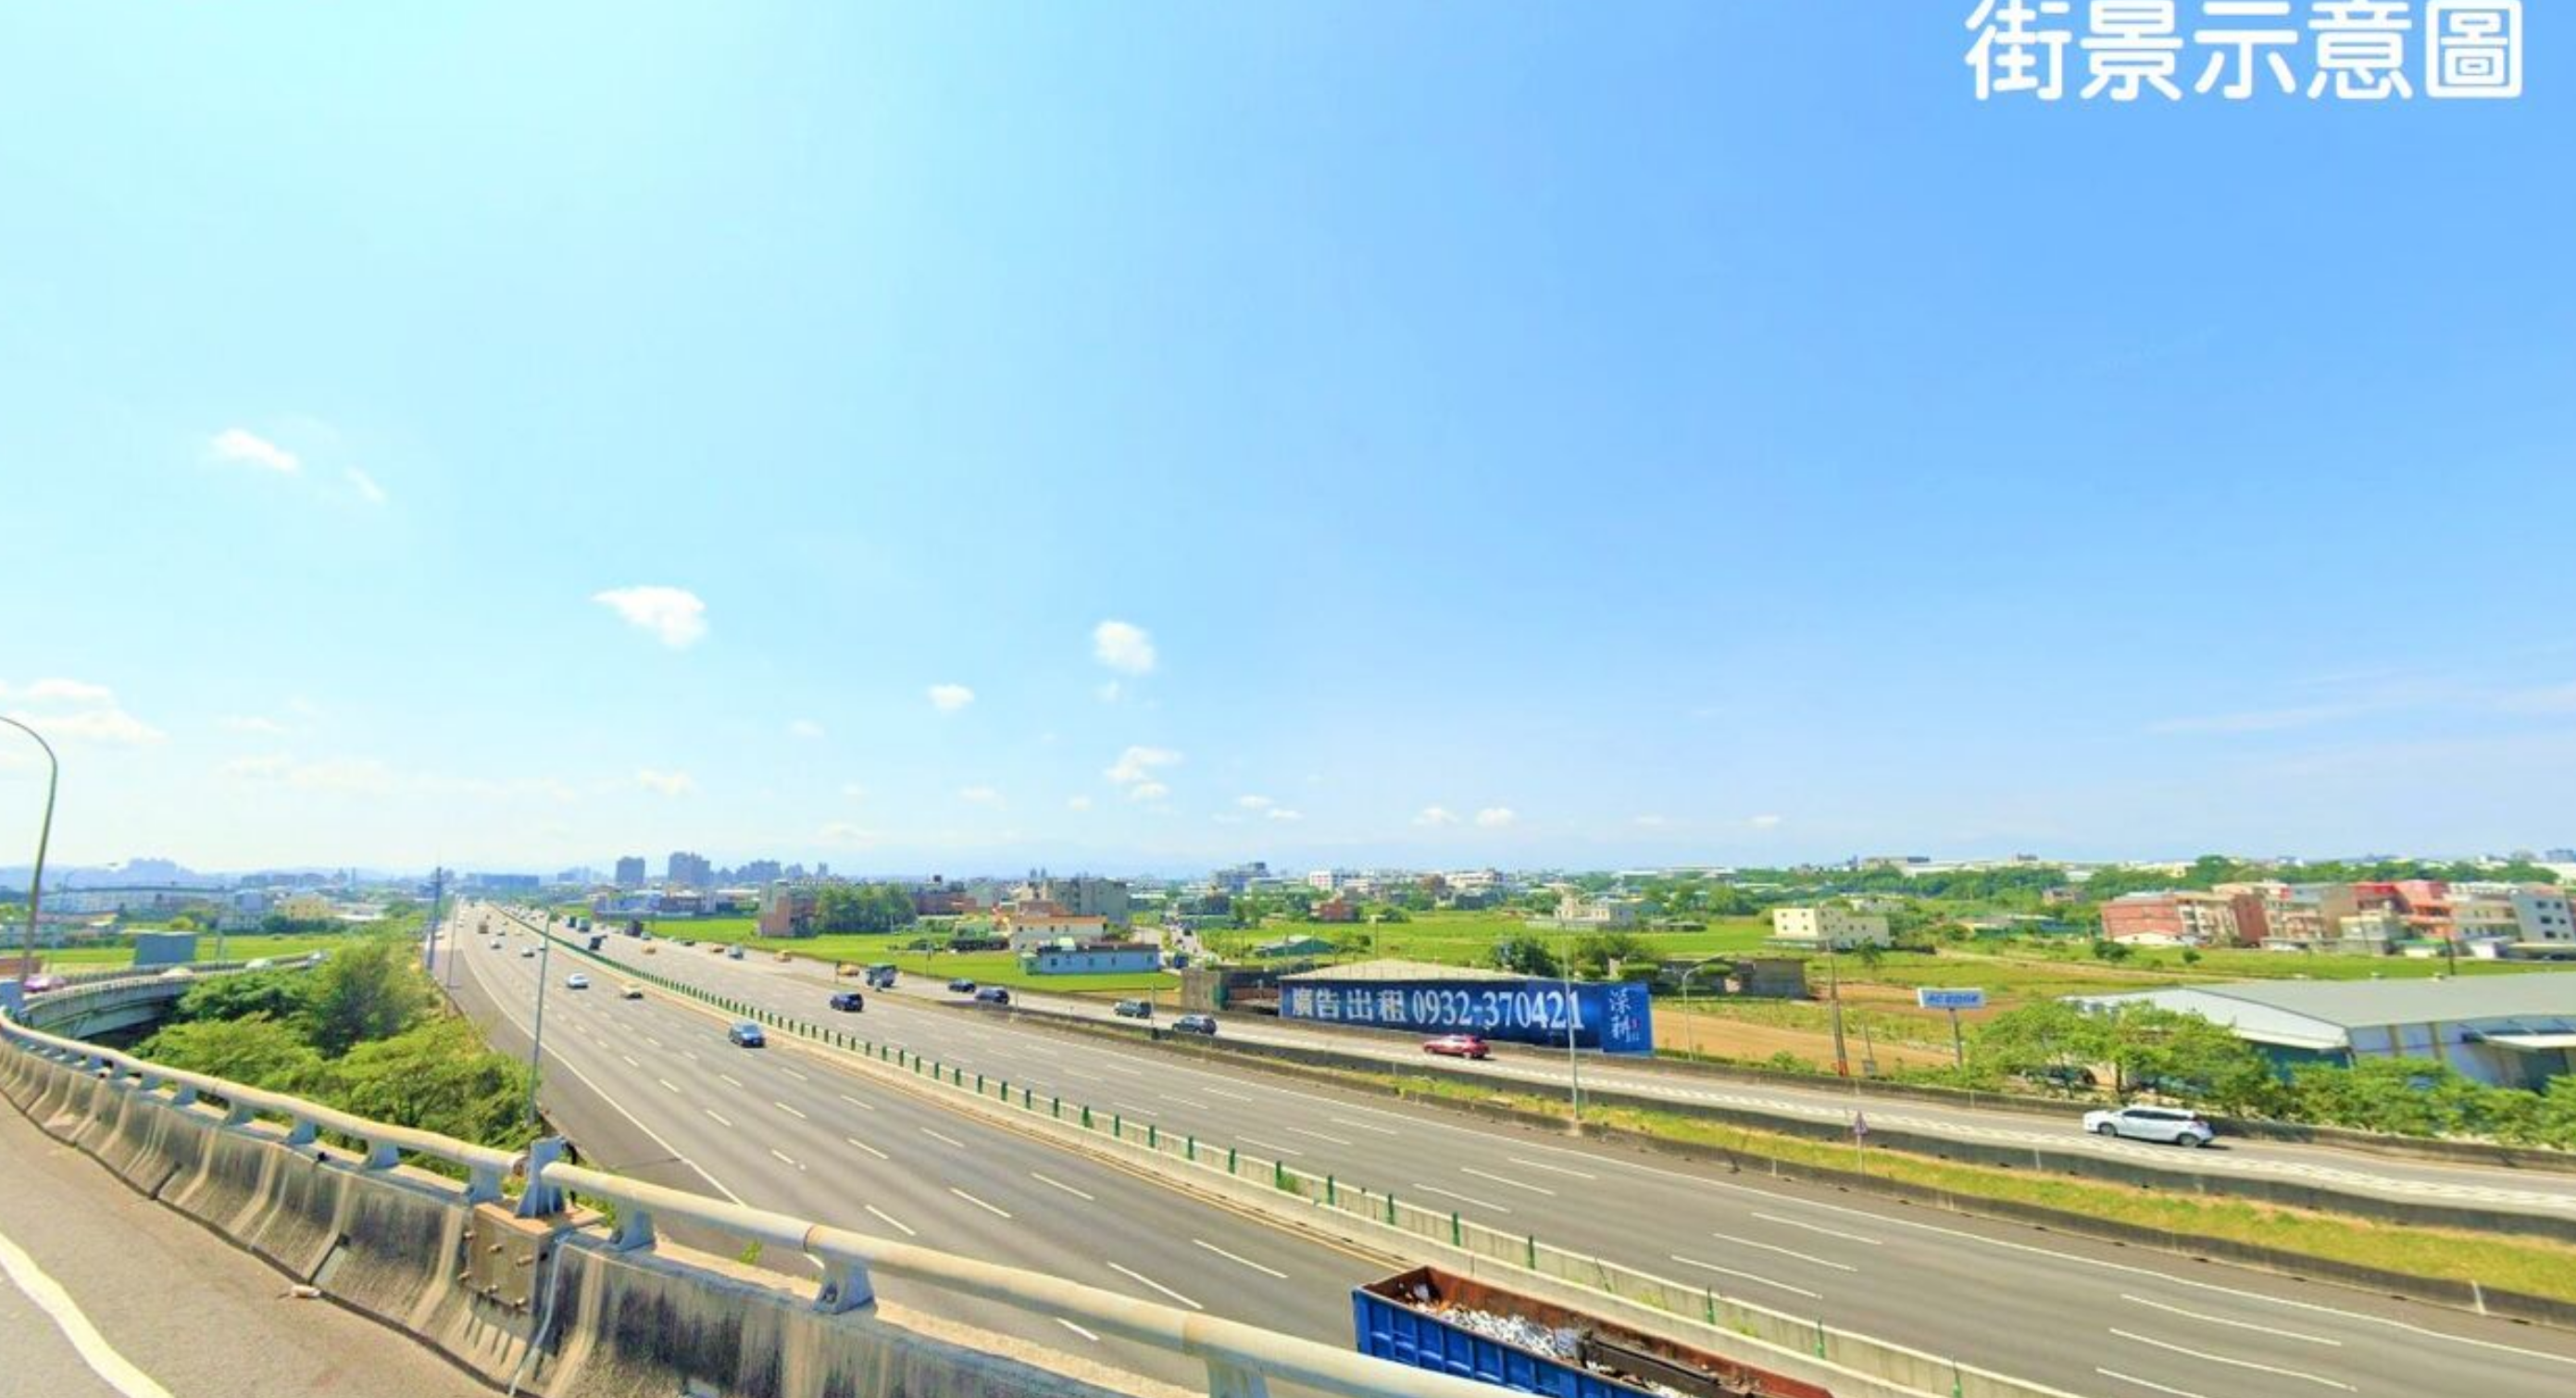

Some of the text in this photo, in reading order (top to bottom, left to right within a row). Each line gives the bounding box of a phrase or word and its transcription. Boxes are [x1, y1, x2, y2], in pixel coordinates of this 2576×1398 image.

[1293, 986, 1584, 1030] 廣告出租 0932-370421
